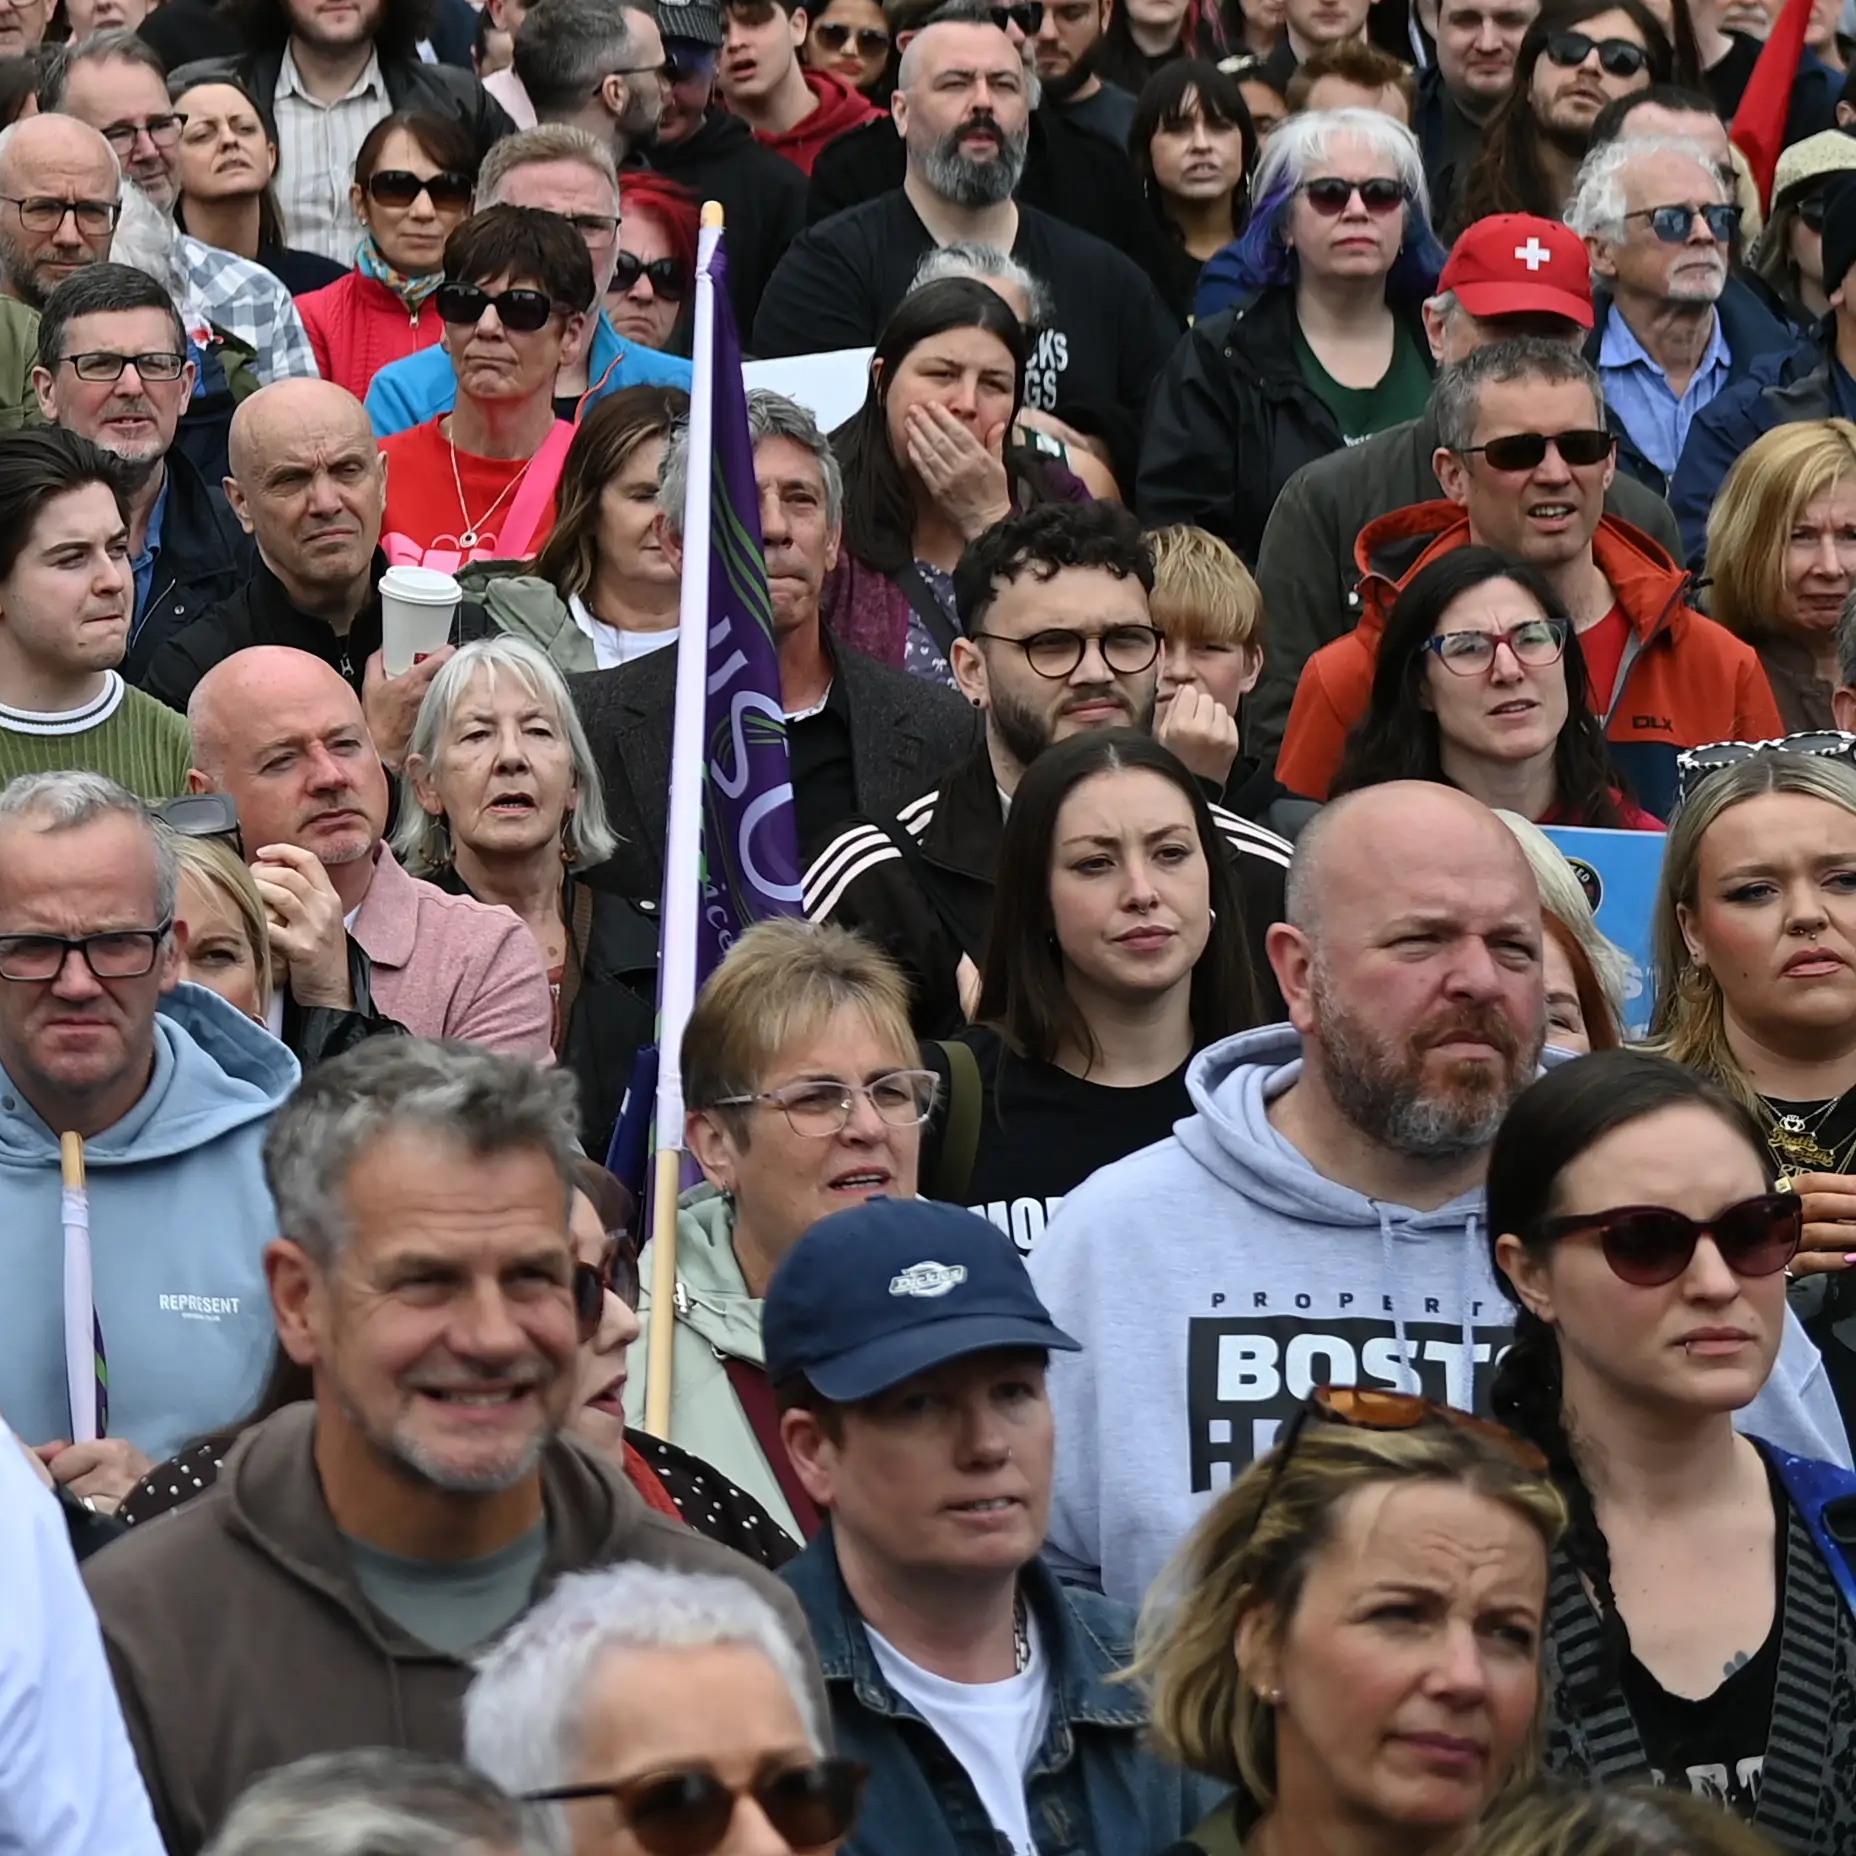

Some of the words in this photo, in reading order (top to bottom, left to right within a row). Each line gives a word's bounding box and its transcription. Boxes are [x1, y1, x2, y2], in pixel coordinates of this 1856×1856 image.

[1632, 715, 1674, 732] DLX
[159, 1293, 241, 1315] REPRESENT
[1211, 1291, 1485, 1318] PROPERT
[1217, 1332, 1512, 1415] BOST
